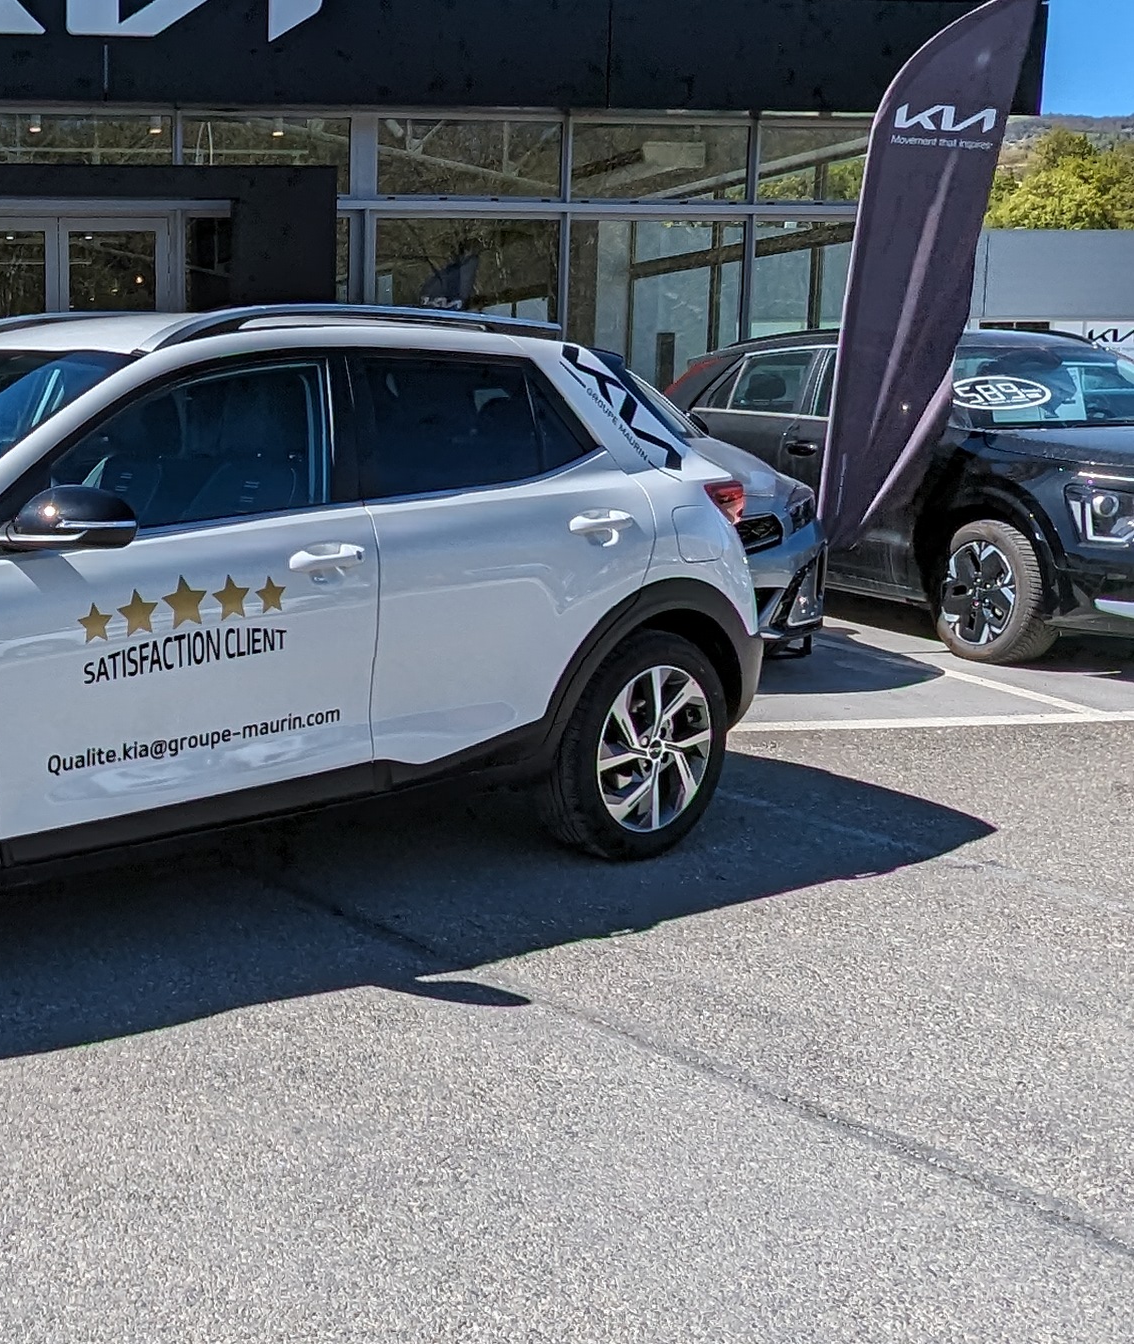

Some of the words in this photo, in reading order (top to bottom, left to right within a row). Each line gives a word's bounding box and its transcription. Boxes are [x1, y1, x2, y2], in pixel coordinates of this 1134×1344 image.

[891, 135, 937, 146] Movement
[894, 103, 997, 133] KIA
[562, 344, 682, 471] KIA
[586, 387, 619, 426] GROUPE
[617, 423, 649, 462] MAURIN
[83, 629, 221, 685] SATISFACTION
[224, 627, 287, 658] CLIENT
[47, 707, 341, 775] Qualite.kia@groupe-maurin.com
